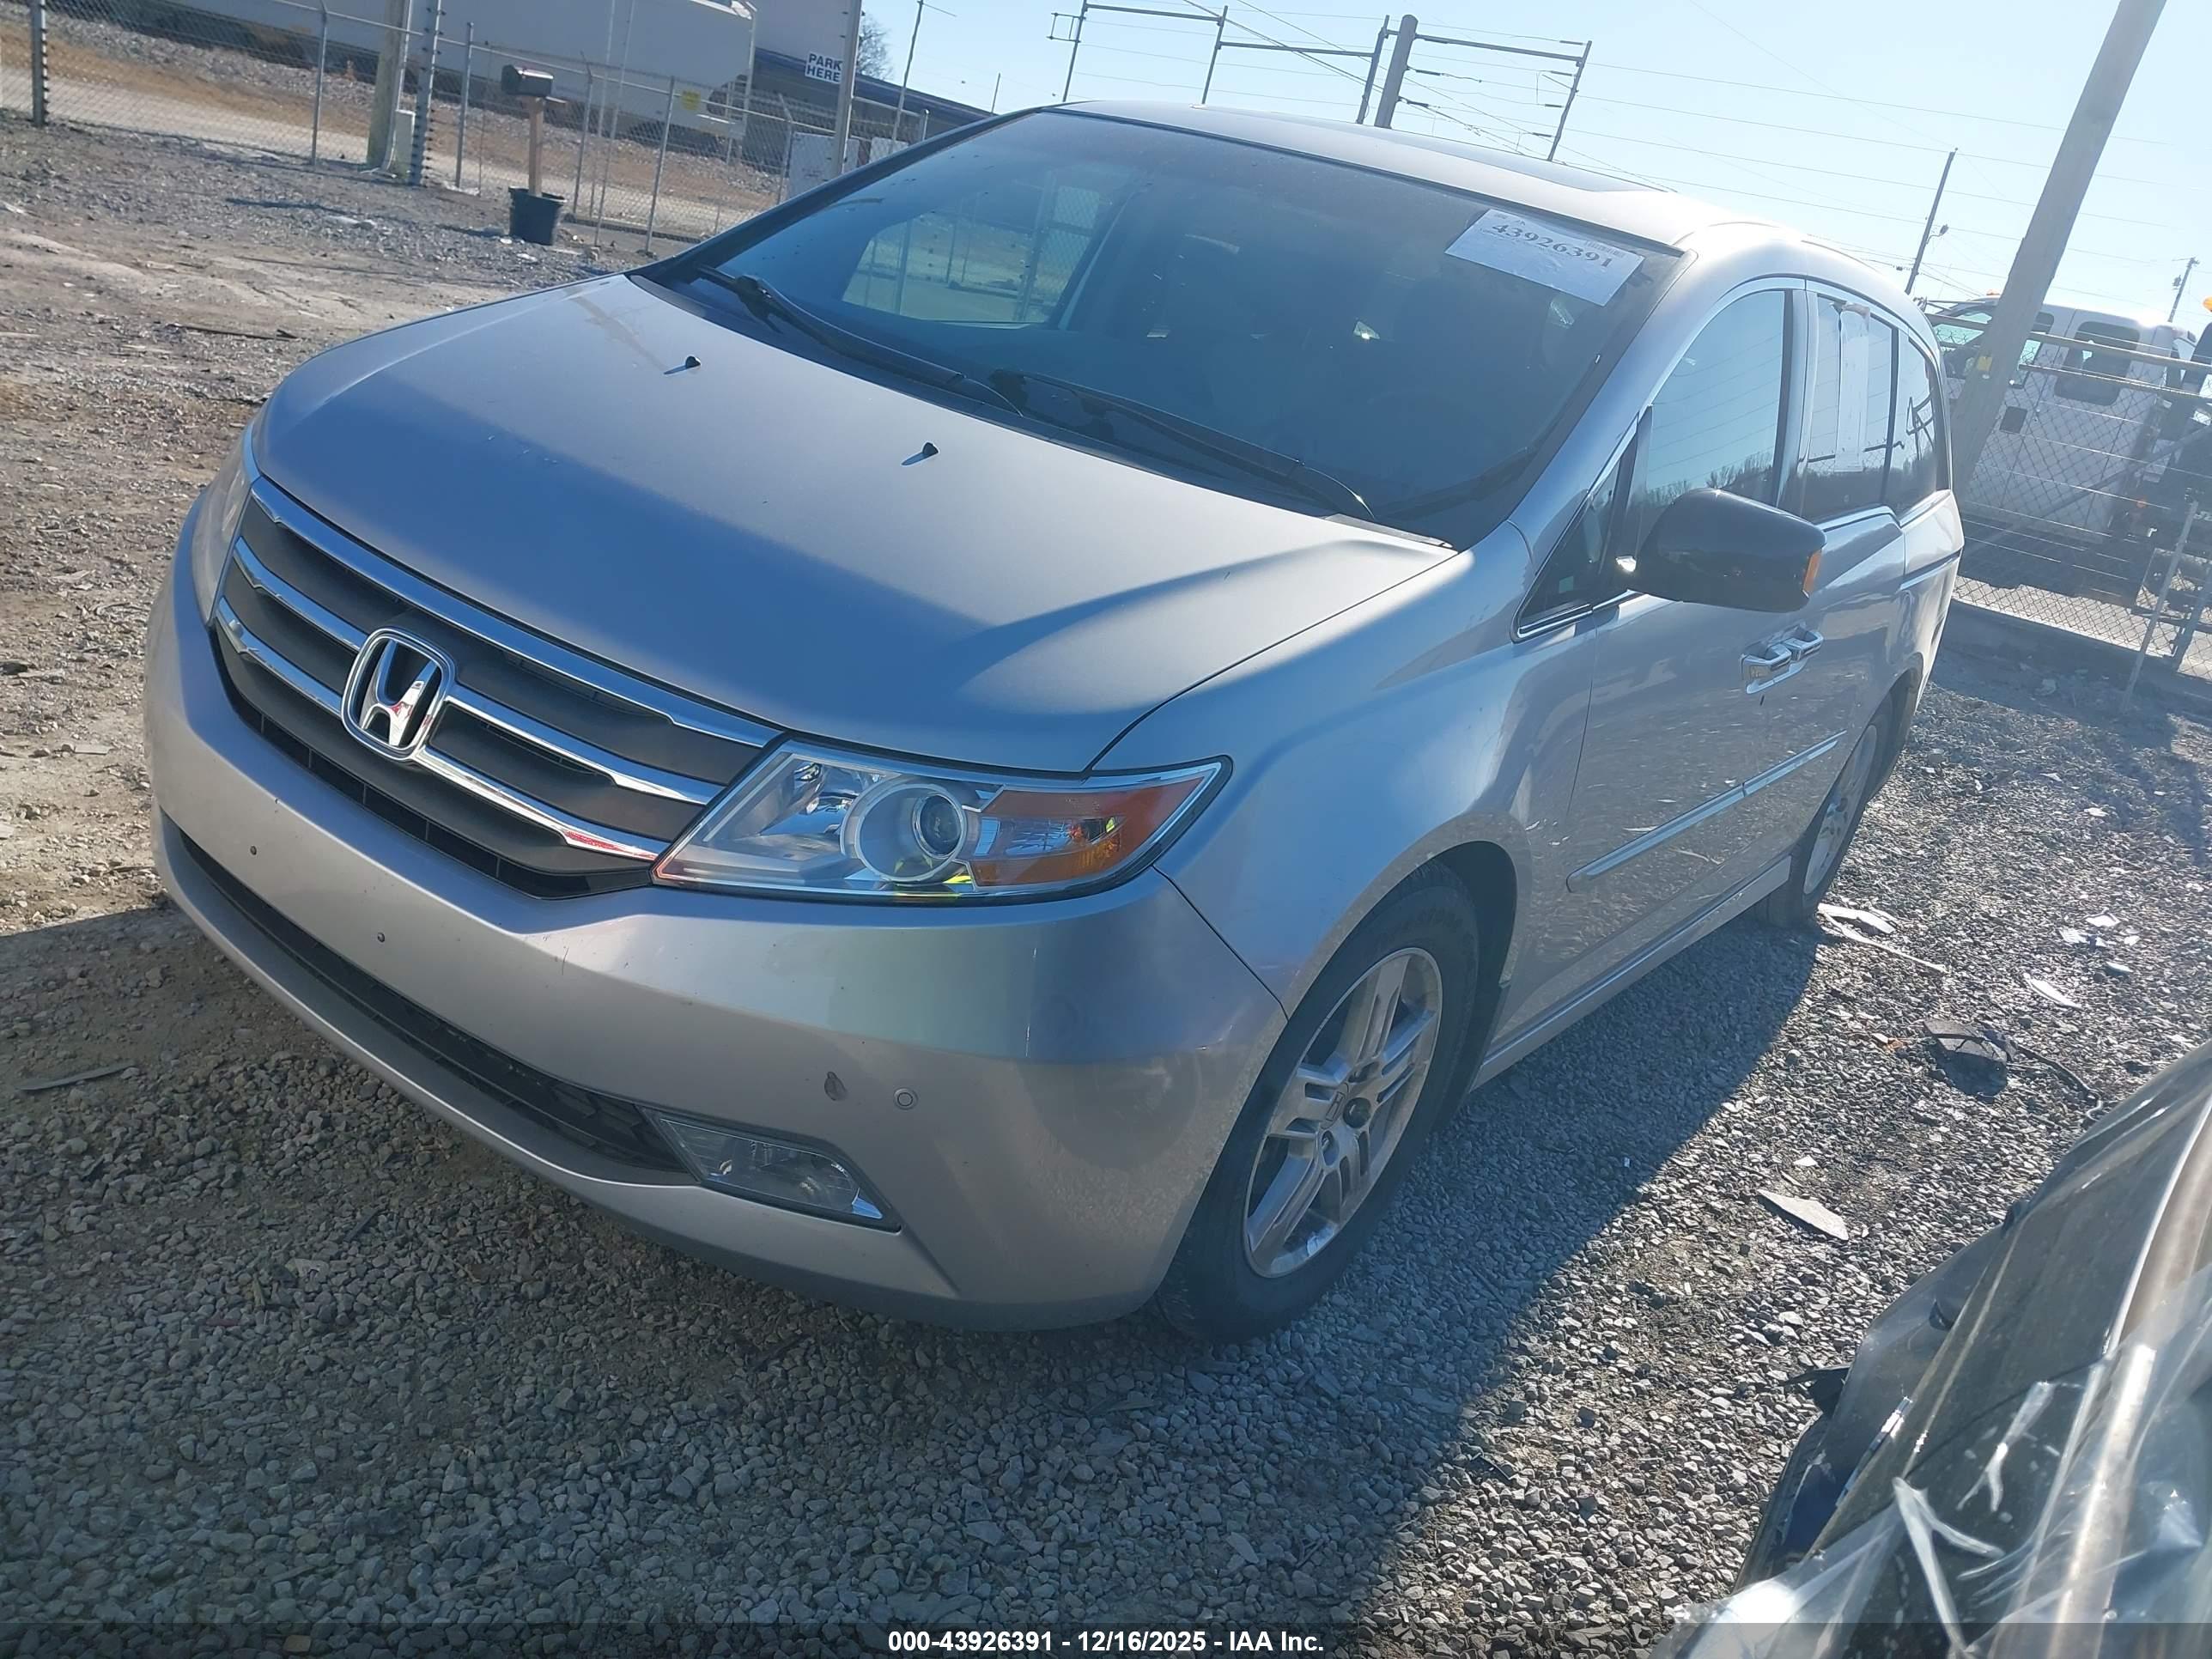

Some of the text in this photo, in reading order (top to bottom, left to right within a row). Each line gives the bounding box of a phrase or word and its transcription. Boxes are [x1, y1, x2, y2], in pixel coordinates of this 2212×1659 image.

[809, 53, 842, 70] PARK
[806, 65, 840, 82] HERE
[1492, 224, 1613, 267] 43926391
